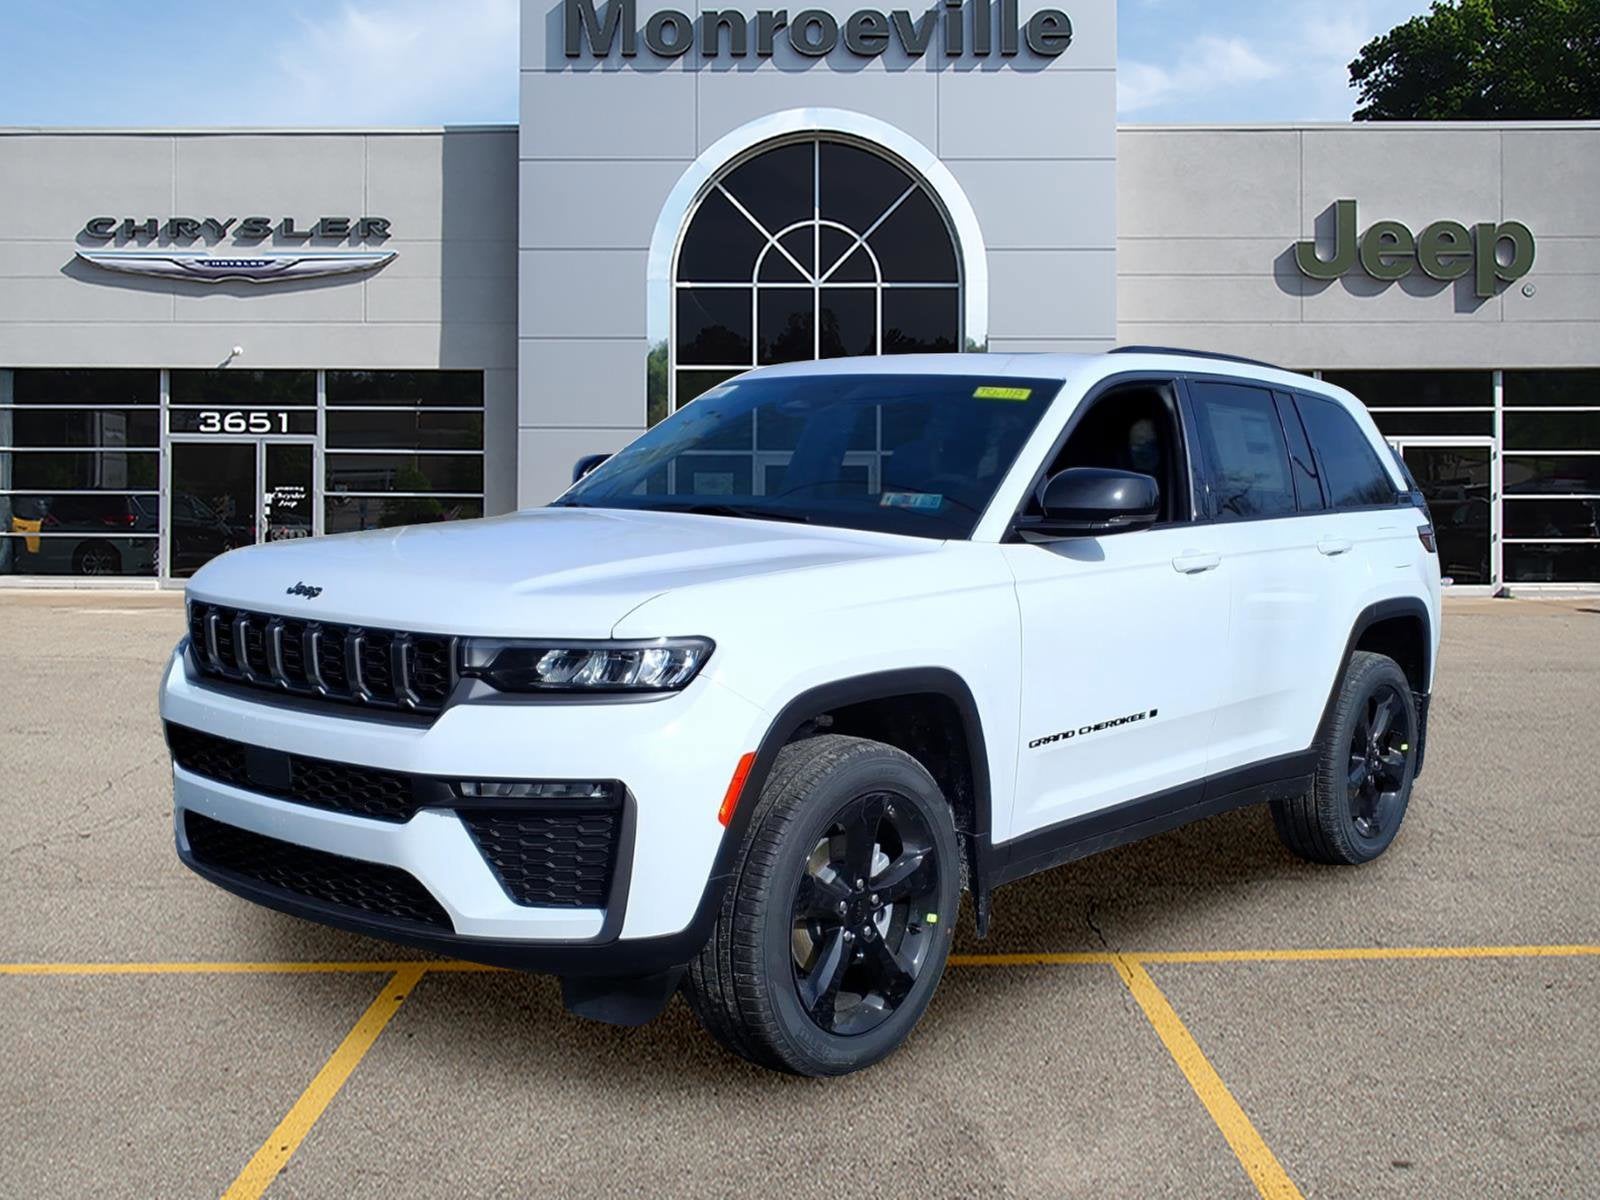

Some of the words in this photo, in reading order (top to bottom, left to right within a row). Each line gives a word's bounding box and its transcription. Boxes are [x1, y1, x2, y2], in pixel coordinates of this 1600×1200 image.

[564, 0, 1073, 57] Monroeville
[86, 217, 392, 238] CHRYSLER
[1295, 200, 1535, 297] Jeep
[199, 411, 288, 433] 3651
[286, 581, 323, 600] Jeep
[1028, 730, 1075, 748] GRAND
[1078, 712, 1146, 735] CHEROKEE
